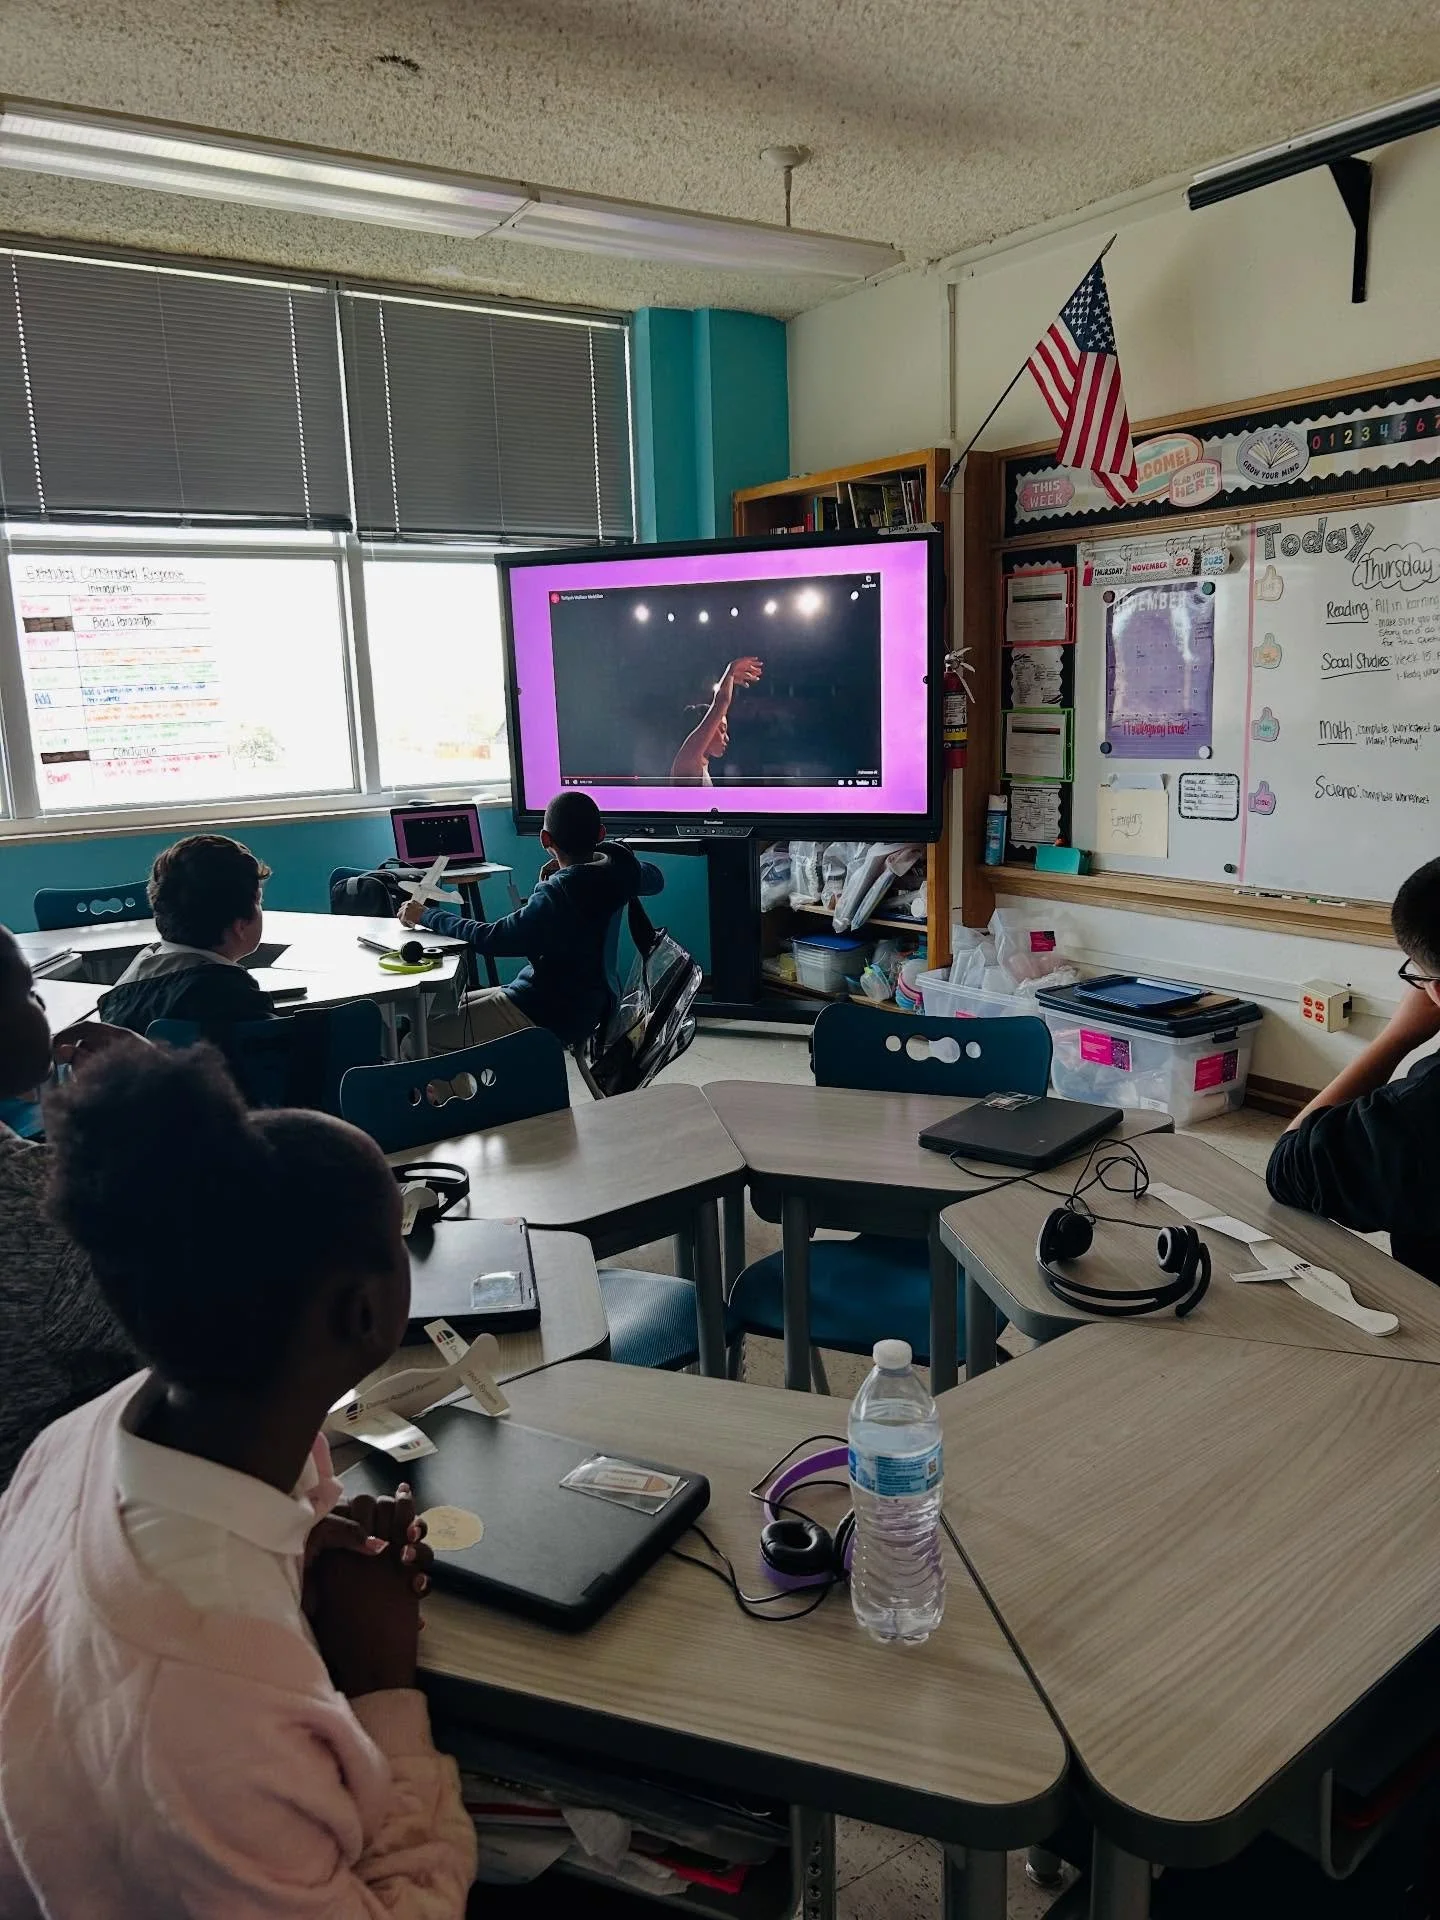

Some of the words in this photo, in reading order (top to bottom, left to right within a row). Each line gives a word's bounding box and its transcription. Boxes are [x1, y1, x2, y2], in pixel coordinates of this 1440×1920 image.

[1312, 435, 1321, 450] 0
[1329, 434, 1335, 447] 1
[1344, 429, 1353, 445] 2
[1361, 426, 1371, 442] 3
[1380, 423, 1389, 438] 4
[1399, 419, 1408, 434] 5
[1415, 417, 1425, 432] 6
[1138, 446, 1192, 483] COME!
[1243, 460, 1259, 478] GROW
[1261, 471, 1279, 480] YOUR
[1281, 462, 1300, 477] MIND
[1032, 480, 1061, 494] THIS
[1174, 475, 1191, 487] GLAD
[1175, 477, 1216, 498] HERE
[1030, 493, 1064, 508] WEEK
[1256, 516, 1376, 563] Today
[1131, 561, 1168, 572] NOVEMBER
[1362, 553, 1433, 585] Thursday
[1321, 652, 1354, 671] Social
